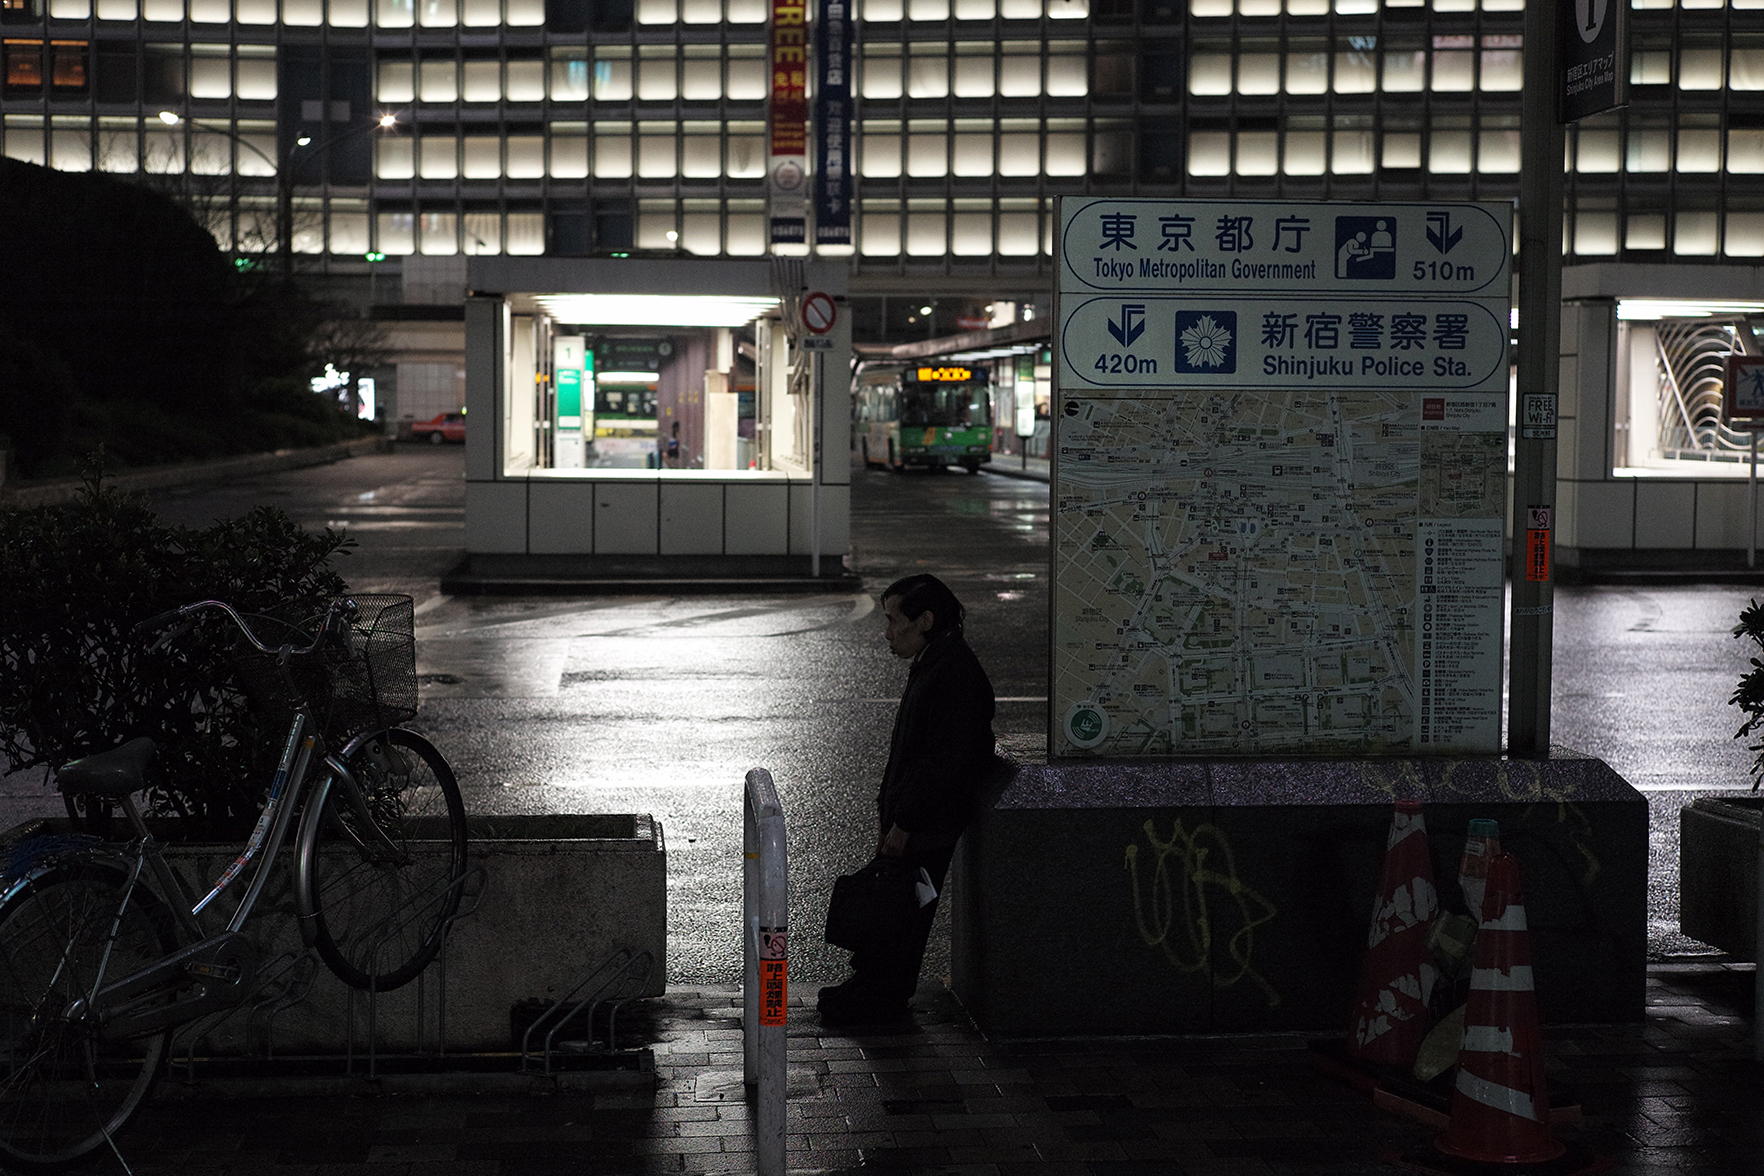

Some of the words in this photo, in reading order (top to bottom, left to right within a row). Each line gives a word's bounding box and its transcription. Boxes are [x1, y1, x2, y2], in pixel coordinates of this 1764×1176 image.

[1585, 77, 1593, 91] City
[1594, 75, 1604, 86] Area
[1099, 212, 1311, 254] 東京都庁
[1093, 257, 1134, 281] Tokyo
[1139, 258, 1226, 283] Metropolitan
[1231, 259, 1316, 280] Government
[1412, 260, 1475, 281] 510m
[1261, 311, 1470, 351] 新宿警察署
[1094, 354, 1158, 374] 420m
[1262, 355, 1354, 379] Shinjuku
[1361, 355, 1425, 377] Police
[1432, 356, 1472, 377] Sta.
[1528, 400, 1552, 411] FREE
[766, 963, 783, 1017] 路上喫煙禁止
